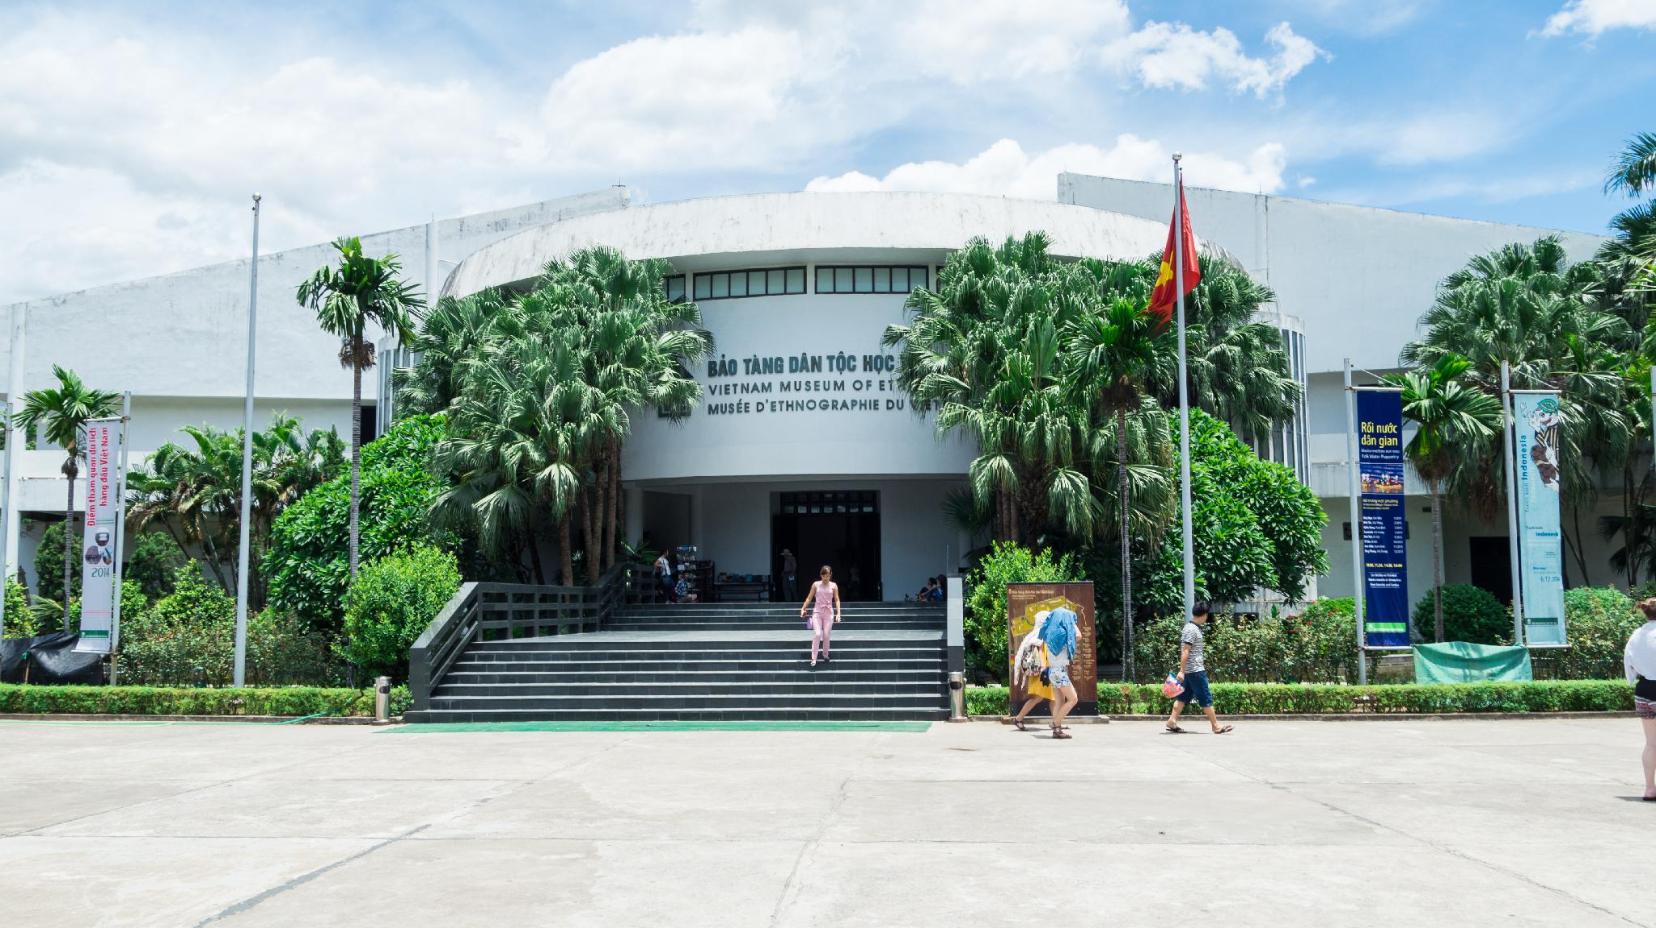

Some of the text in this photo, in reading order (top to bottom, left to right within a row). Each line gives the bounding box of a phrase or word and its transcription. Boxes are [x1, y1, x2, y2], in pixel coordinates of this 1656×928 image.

[708, 351, 895, 378] BẢO TÀNG DÂN TỘC HỌC
[708, 382, 772, 396] VIETNAM
[780, 380, 845, 393] MUSEUM
[852, 379, 872, 391] OF
[708, 398, 750, 415] MUSÉE
[756, 398, 880, 413] D'ETHNOGRAPHIE
[886, 399, 904, 411] DU
[89, 444, 96, 455] du
[1361, 434, 1398, 448] dân gian
[90, 457, 98, 478] quan
[88, 481, 96, 503] tham
